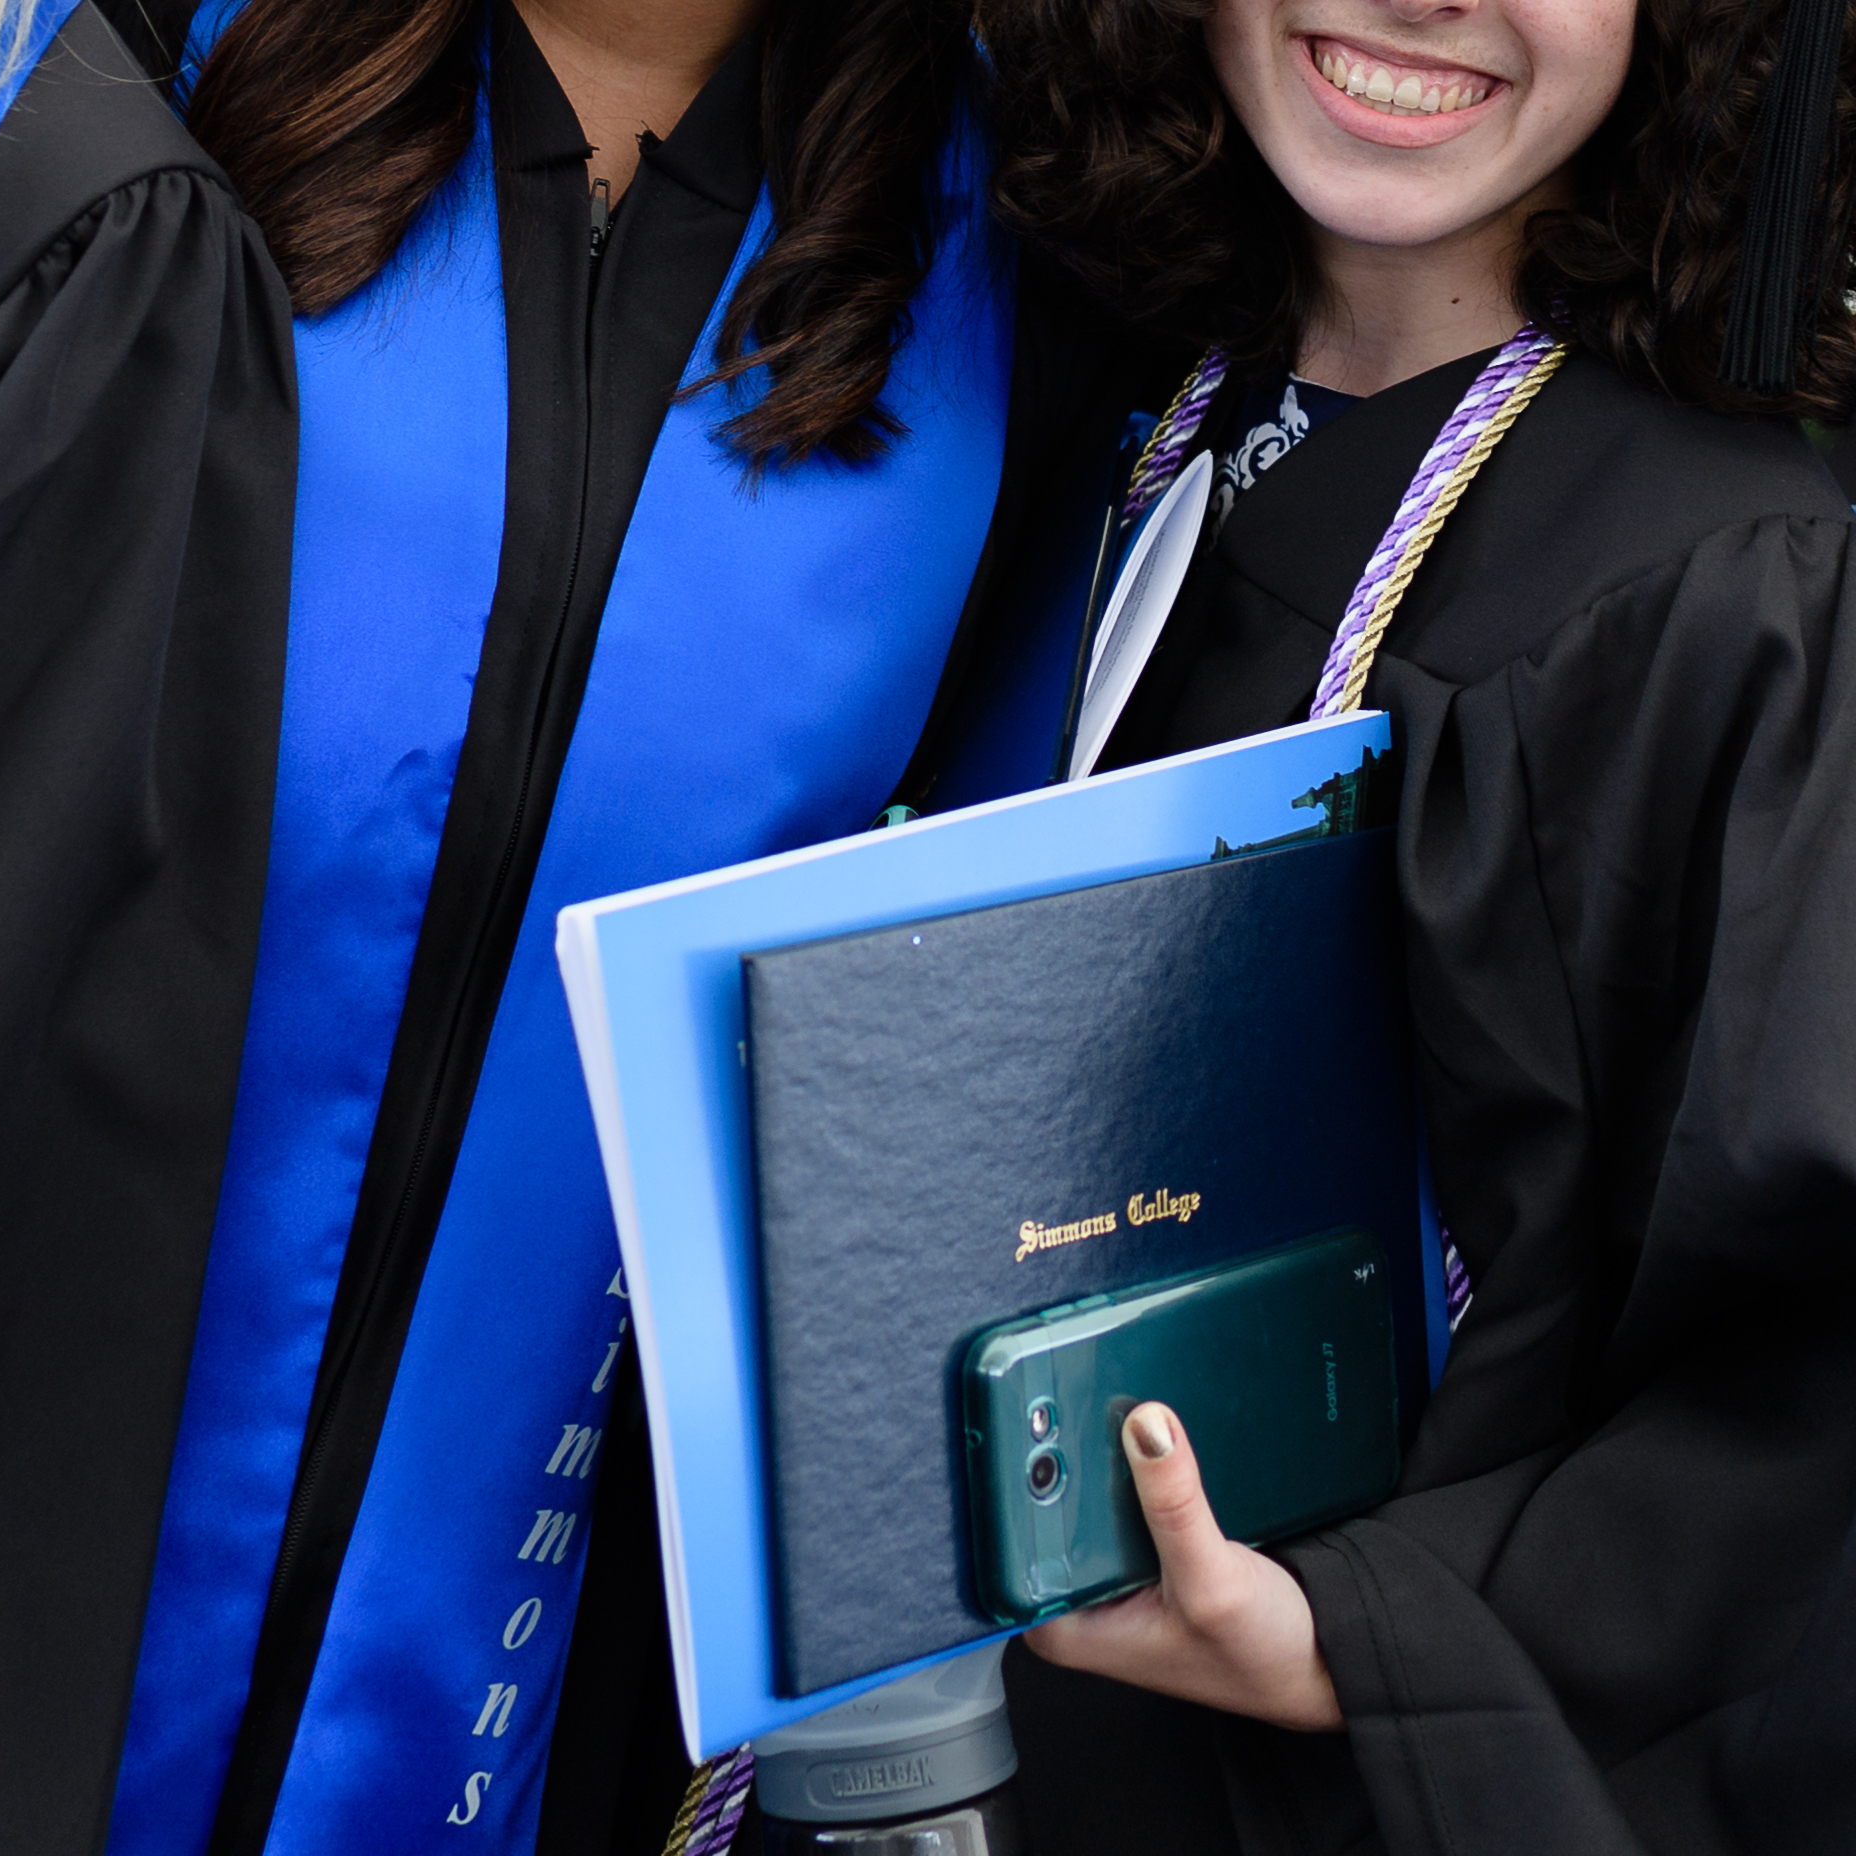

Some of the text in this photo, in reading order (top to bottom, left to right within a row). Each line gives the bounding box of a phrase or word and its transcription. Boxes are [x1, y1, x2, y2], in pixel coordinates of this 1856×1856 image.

[1015, 1187, 1201, 1263] Simmons College
[1322, 1342, 1338, 1422] Galaxy J7
[831, 1756, 935, 1797] CAMELBAK
